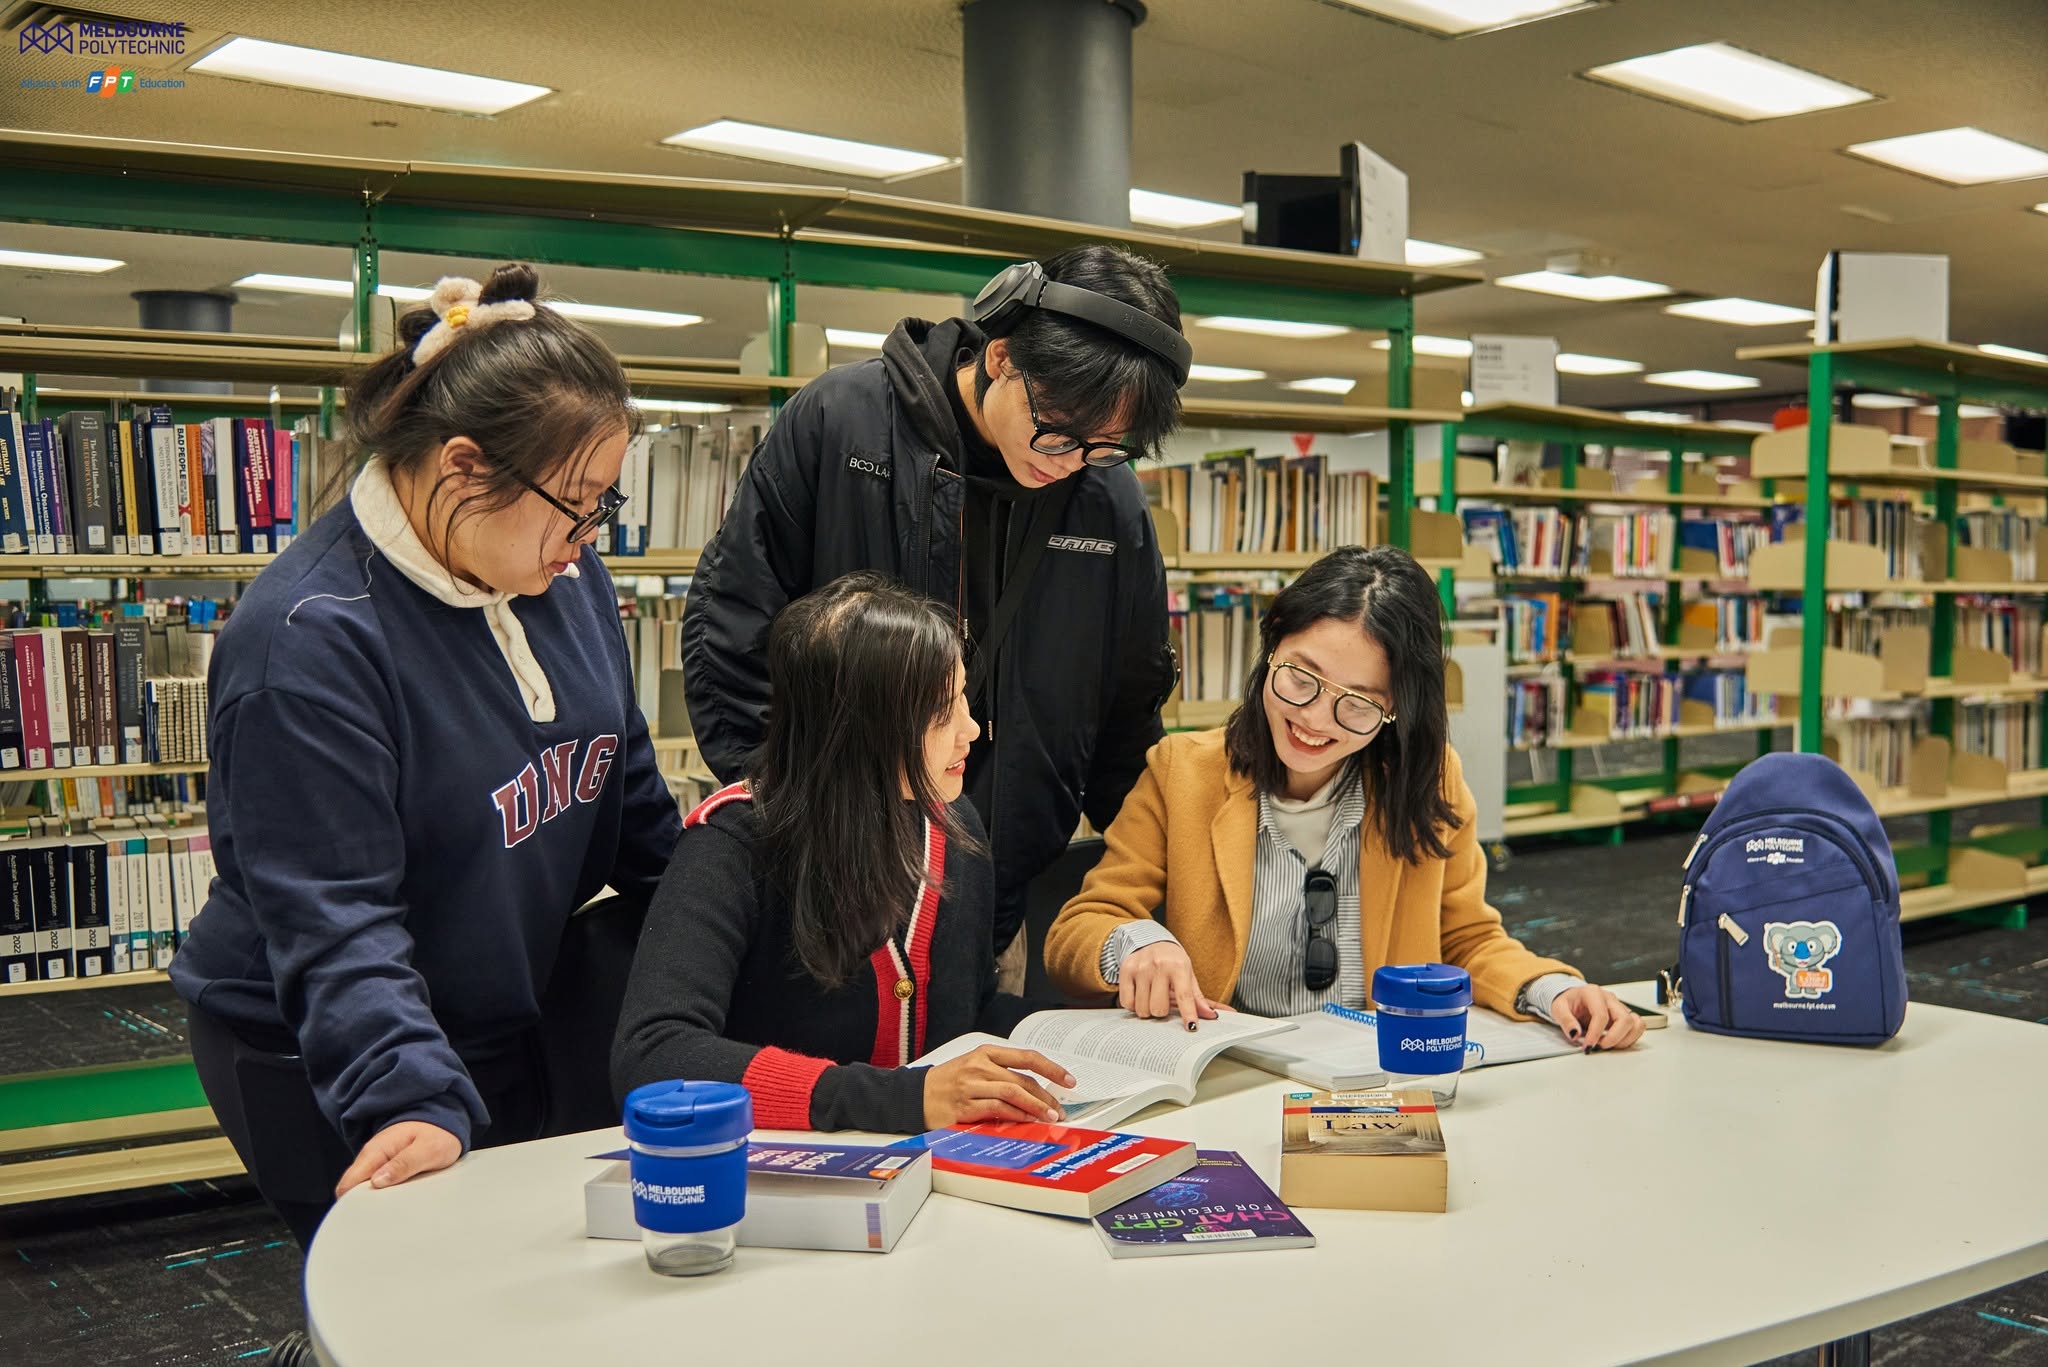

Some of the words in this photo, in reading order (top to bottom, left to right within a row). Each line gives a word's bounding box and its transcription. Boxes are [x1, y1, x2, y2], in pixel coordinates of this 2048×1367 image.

[163, 437, 172, 480] INTERNATIONAL
[178, 446, 187, 480] PEOPLE
[252, 428, 264, 480] AUSTRALIAN
[36, 450, 47, 491] INTERNATIONAL
[83, 452, 92, 487] EUROPEAN
[246, 428, 262, 504] CONSTITUTIONAL
[16, 438, 26, 477] International
[21, 478, 32, 519] Organizations
[92, 471, 100, 499] Handbook
[85, 488, 93, 509] UNION
[93, 500, 101, 508] of
[165, 481, 174, 505] BUSINESS
[247, 493, 255, 516] THEORY
[0, 650, 9, 676] SECURITY
[50, 637, 59, 676] international
[76, 643, 84, 676] INTERNATIONAL
[102, 643, 110, 676] INTERNATIONAL
[3, 684, 11, 709] PAYMENT
[491, 734, 618, 849] UNG
[1764, 837, 1803, 846] MELBOURNE
[12, 891, 21, 920] Legislation
[49, 888, 58, 917] Legislation
[89, 886, 97, 914] Legislation
[13, 935, 21, 954] 2022
[89, 928, 97, 948] 2022
[1426, 1034, 1463, 1046] MELBOURNE
[1426, 1042, 1463, 1052] POLYTECHNIC
[1314, 1098, 1405, 1107] Oxford
[1324, 1120, 1403, 1130] Law
[1106, 1135, 1121, 1143] and
[1058, 1140, 1107, 1165] Southeast
[1031, 1161, 1061, 1175] Asia
[1045, 1167, 1075, 1182] East
[647, 1184, 705, 1197] MELBOURNE
[648, 1193, 706, 1205] POLYTECHNIC
[1113, 1206, 1224, 1221] BEGINNERS
[1194, 1210, 1289, 1226] CHAT
[1234, 1203, 1272, 1211] FOR
[1109, 1218, 1183, 1230] GPT
